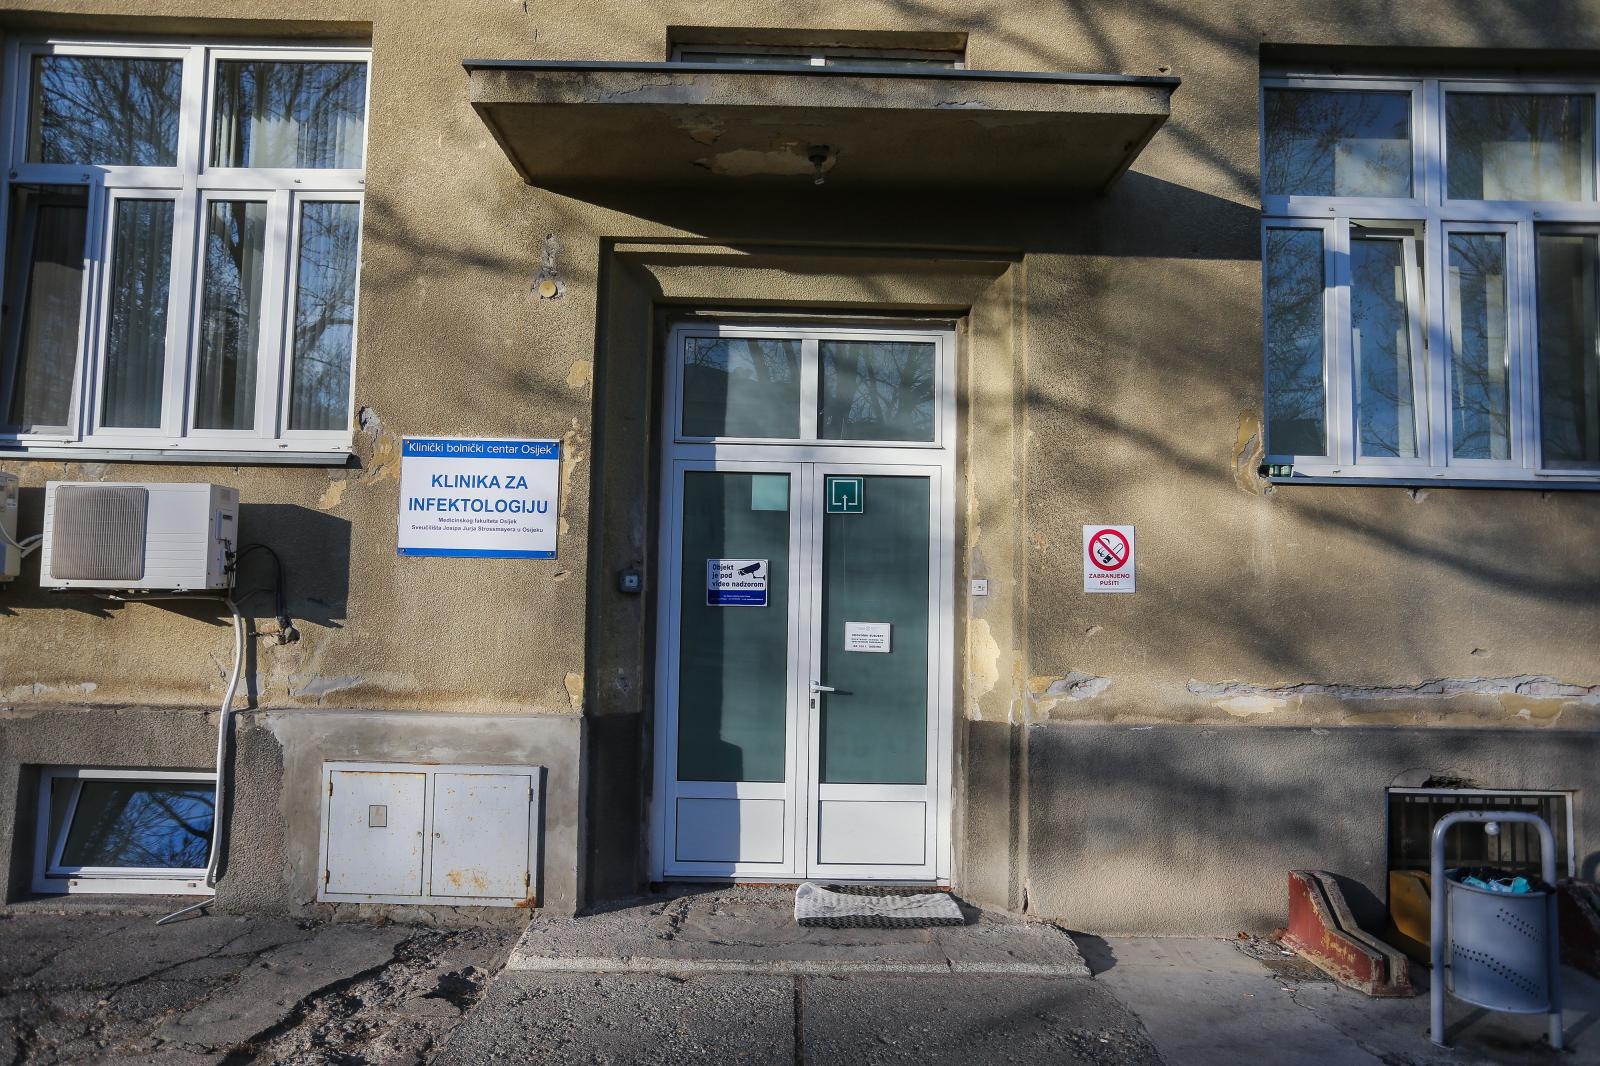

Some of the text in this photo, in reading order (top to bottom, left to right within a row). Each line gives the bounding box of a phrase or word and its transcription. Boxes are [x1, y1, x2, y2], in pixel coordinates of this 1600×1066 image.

[409, 442, 552, 456] Klinički bolnički centar Osijek
[431, 474, 528, 489] KLINIKA ZA
[408, 497, 548, 514] INFEKTOLOGIJU
[522, 526, 543, 534] Osijeku
[711, 571, 719, 579] je
[711, 580, 730, 588] video
